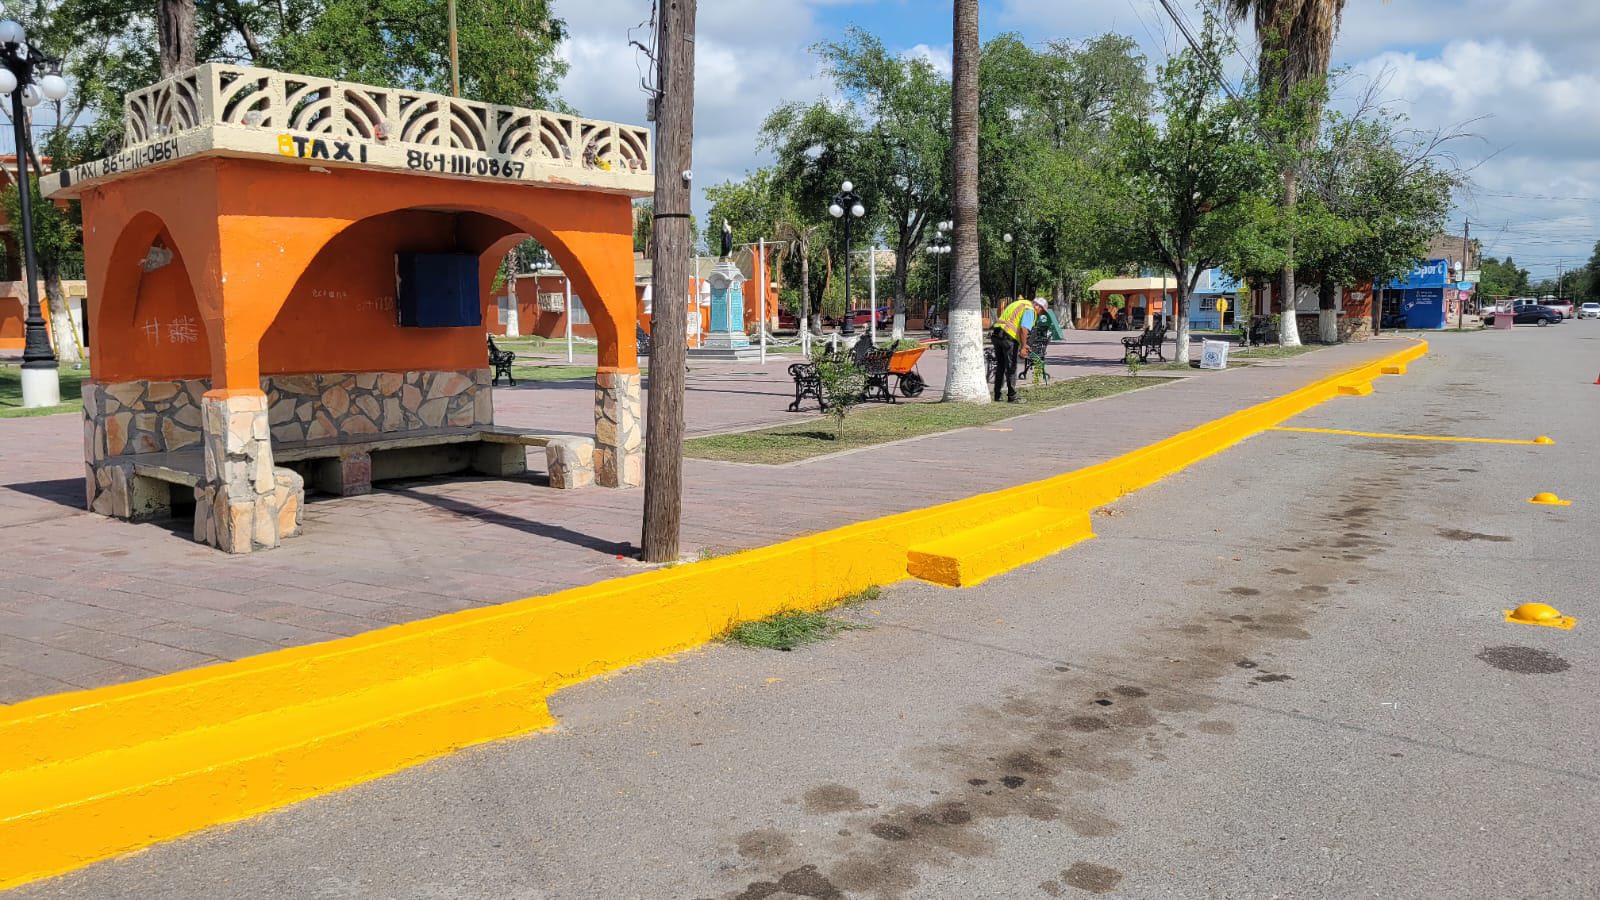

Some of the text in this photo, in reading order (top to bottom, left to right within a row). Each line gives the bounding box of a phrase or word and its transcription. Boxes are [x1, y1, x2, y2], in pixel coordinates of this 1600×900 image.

[75, 137, 180, 182] TAXI 864-111-0864
[1414, 262, 1444, 279] Sport
